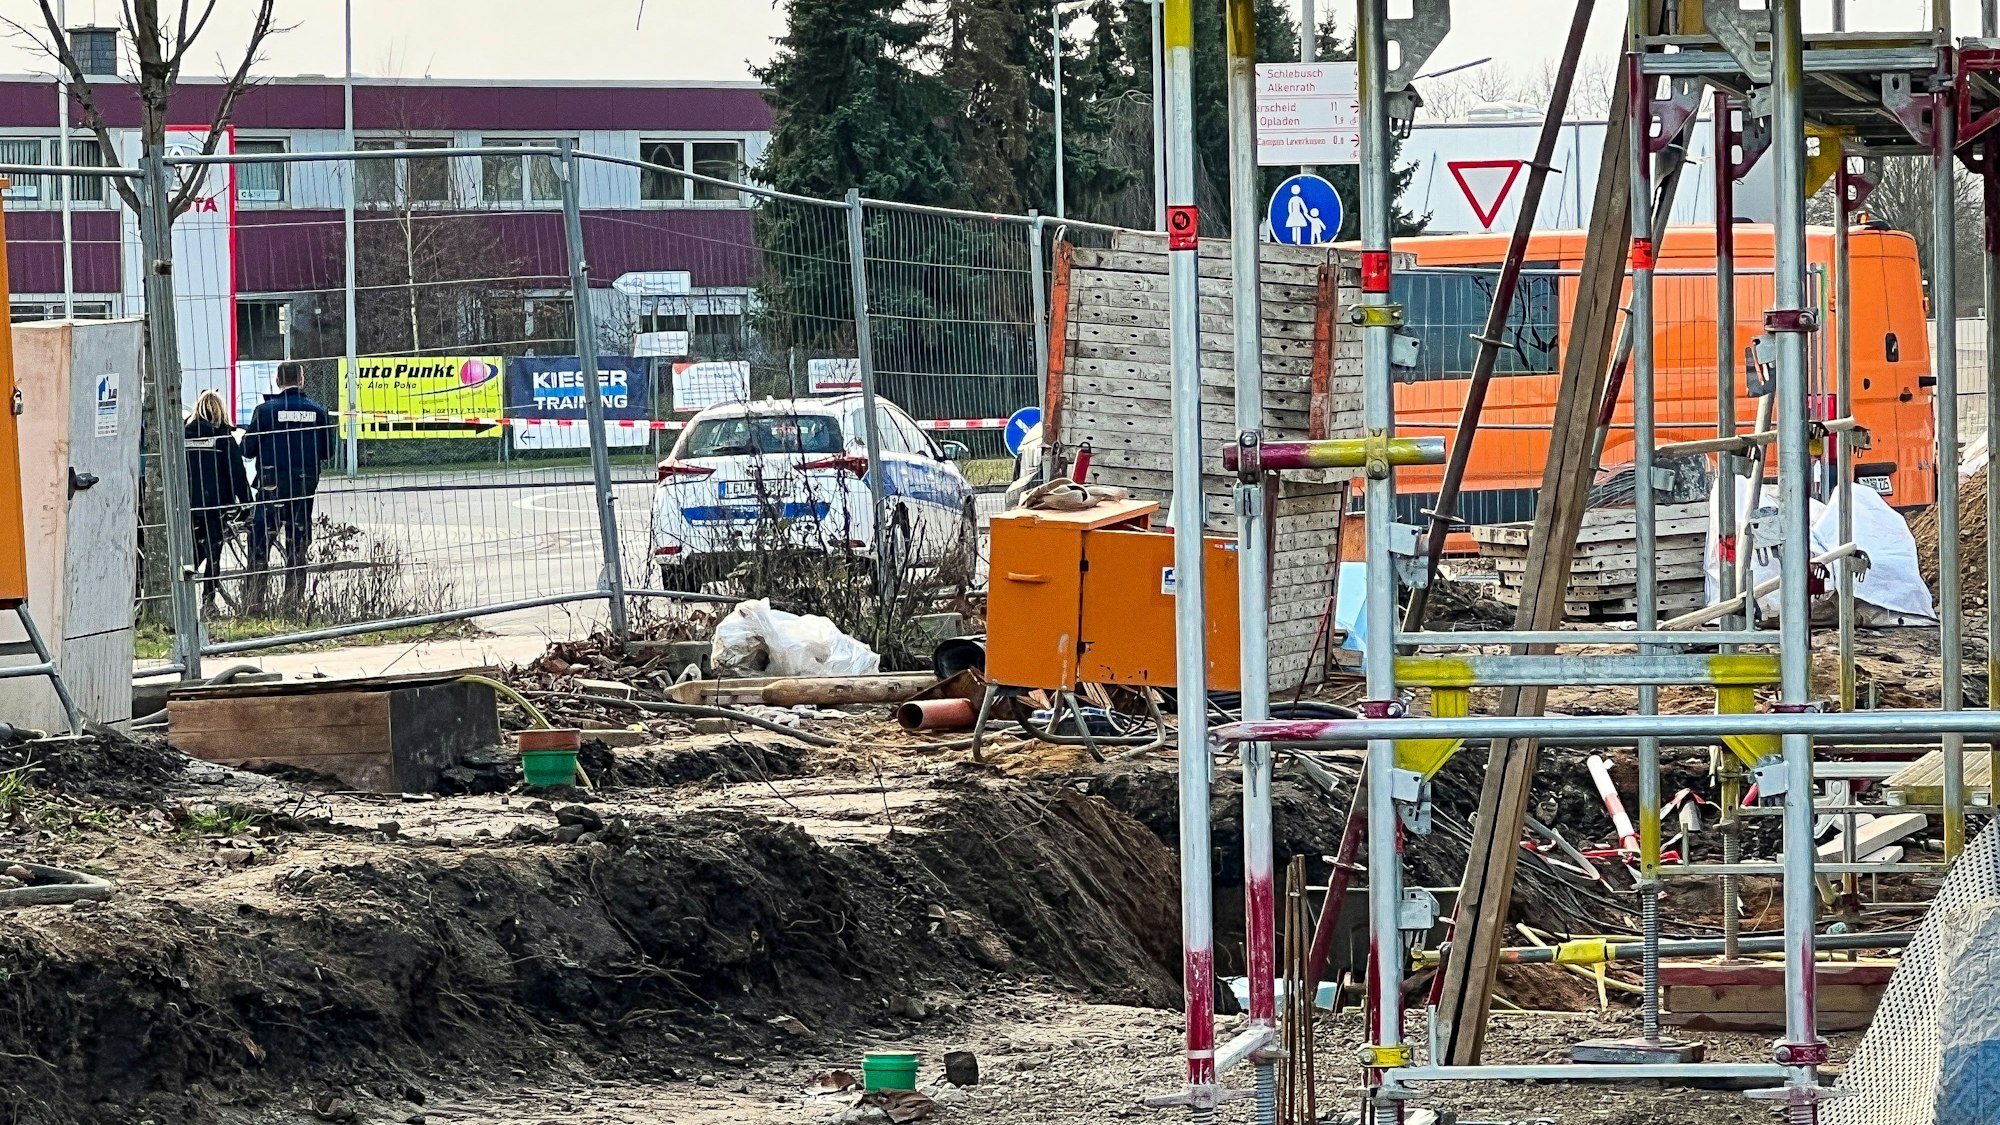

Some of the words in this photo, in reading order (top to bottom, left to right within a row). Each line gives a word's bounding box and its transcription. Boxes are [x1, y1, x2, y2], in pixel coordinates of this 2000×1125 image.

[1267, 68, 1323, 79] Schlebusch
[1267, 83, 1316, 92] Alkenrath
[1260, 117, 1300, 128] Opladen
